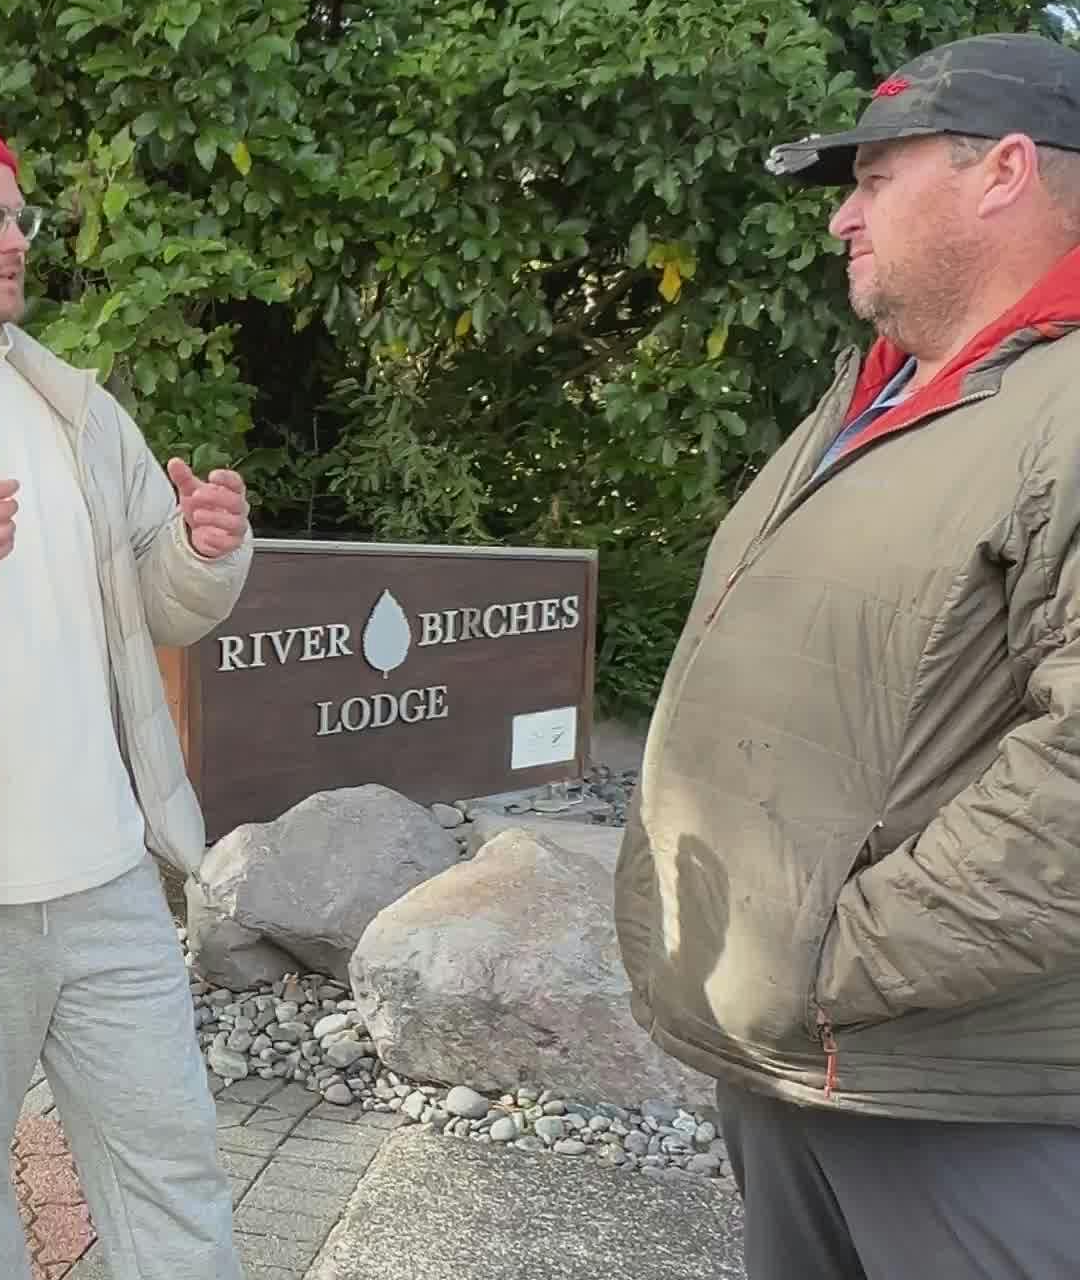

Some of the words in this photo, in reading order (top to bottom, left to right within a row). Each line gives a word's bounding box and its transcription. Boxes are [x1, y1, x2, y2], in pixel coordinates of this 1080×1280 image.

[218, 623, 353, 671] RIVER
[418, 595, 580, 647] BIRCHES
[316, 685, 449, 736] LODGE
